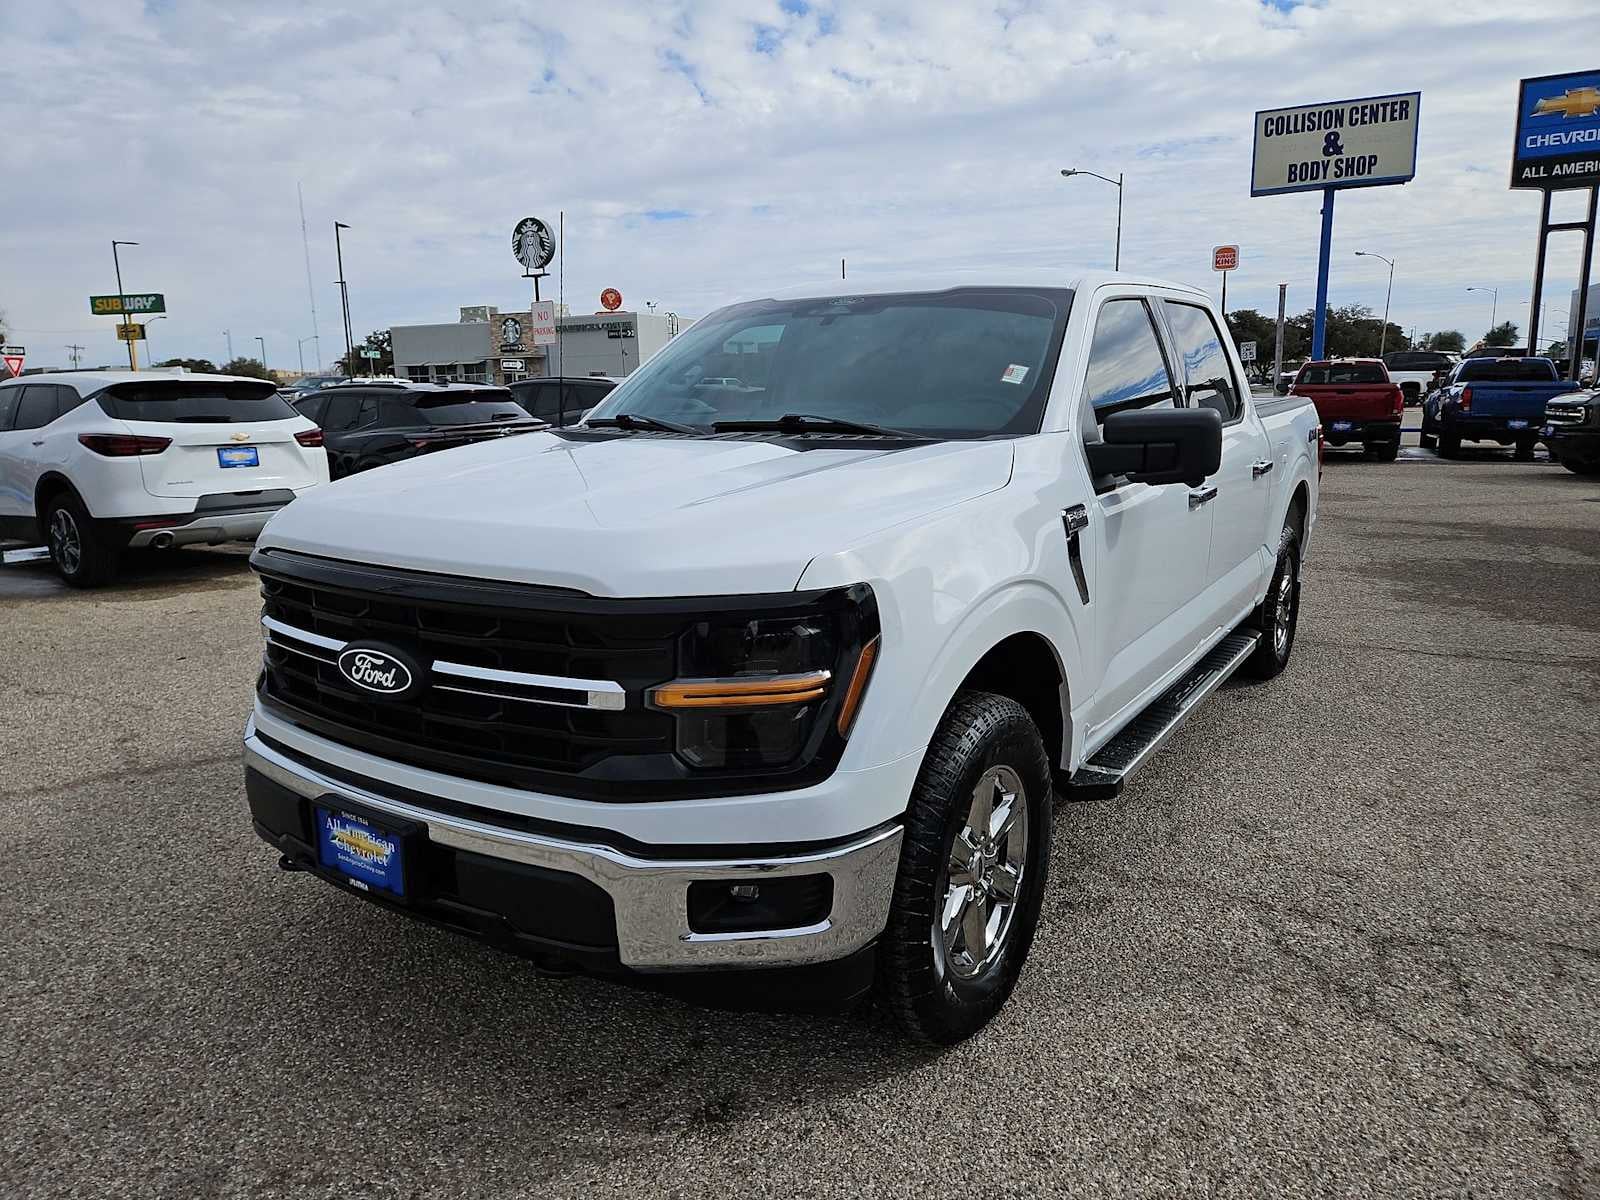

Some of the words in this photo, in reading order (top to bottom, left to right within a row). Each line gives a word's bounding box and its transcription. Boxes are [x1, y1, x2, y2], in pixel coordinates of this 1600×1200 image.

[1264, 108, 1344, 137] COLLISION
[1348, 100, 1409, 127] CENTER
[1322, 131, 1344, 157] &
[1526, 128, 1600, 148] CHEVRO
[1288, 160, 1330, 183] BODY
[1334, 155, 1377, 178] SHOP
[1522, 166, 1548, 179] ALL
[1552, 160, 1600, 176] AMERI
[95, 296, 155, 311] SUBWAY
[537, 311, 549, 321] NO
[534, 326, 554, 336] PARKING
[352, 654, 396, 687] Ford
[326, 817, 341, 833] All
[345, 823, 395, 853] American
[336, 836, 388, 866] Chevrolet
